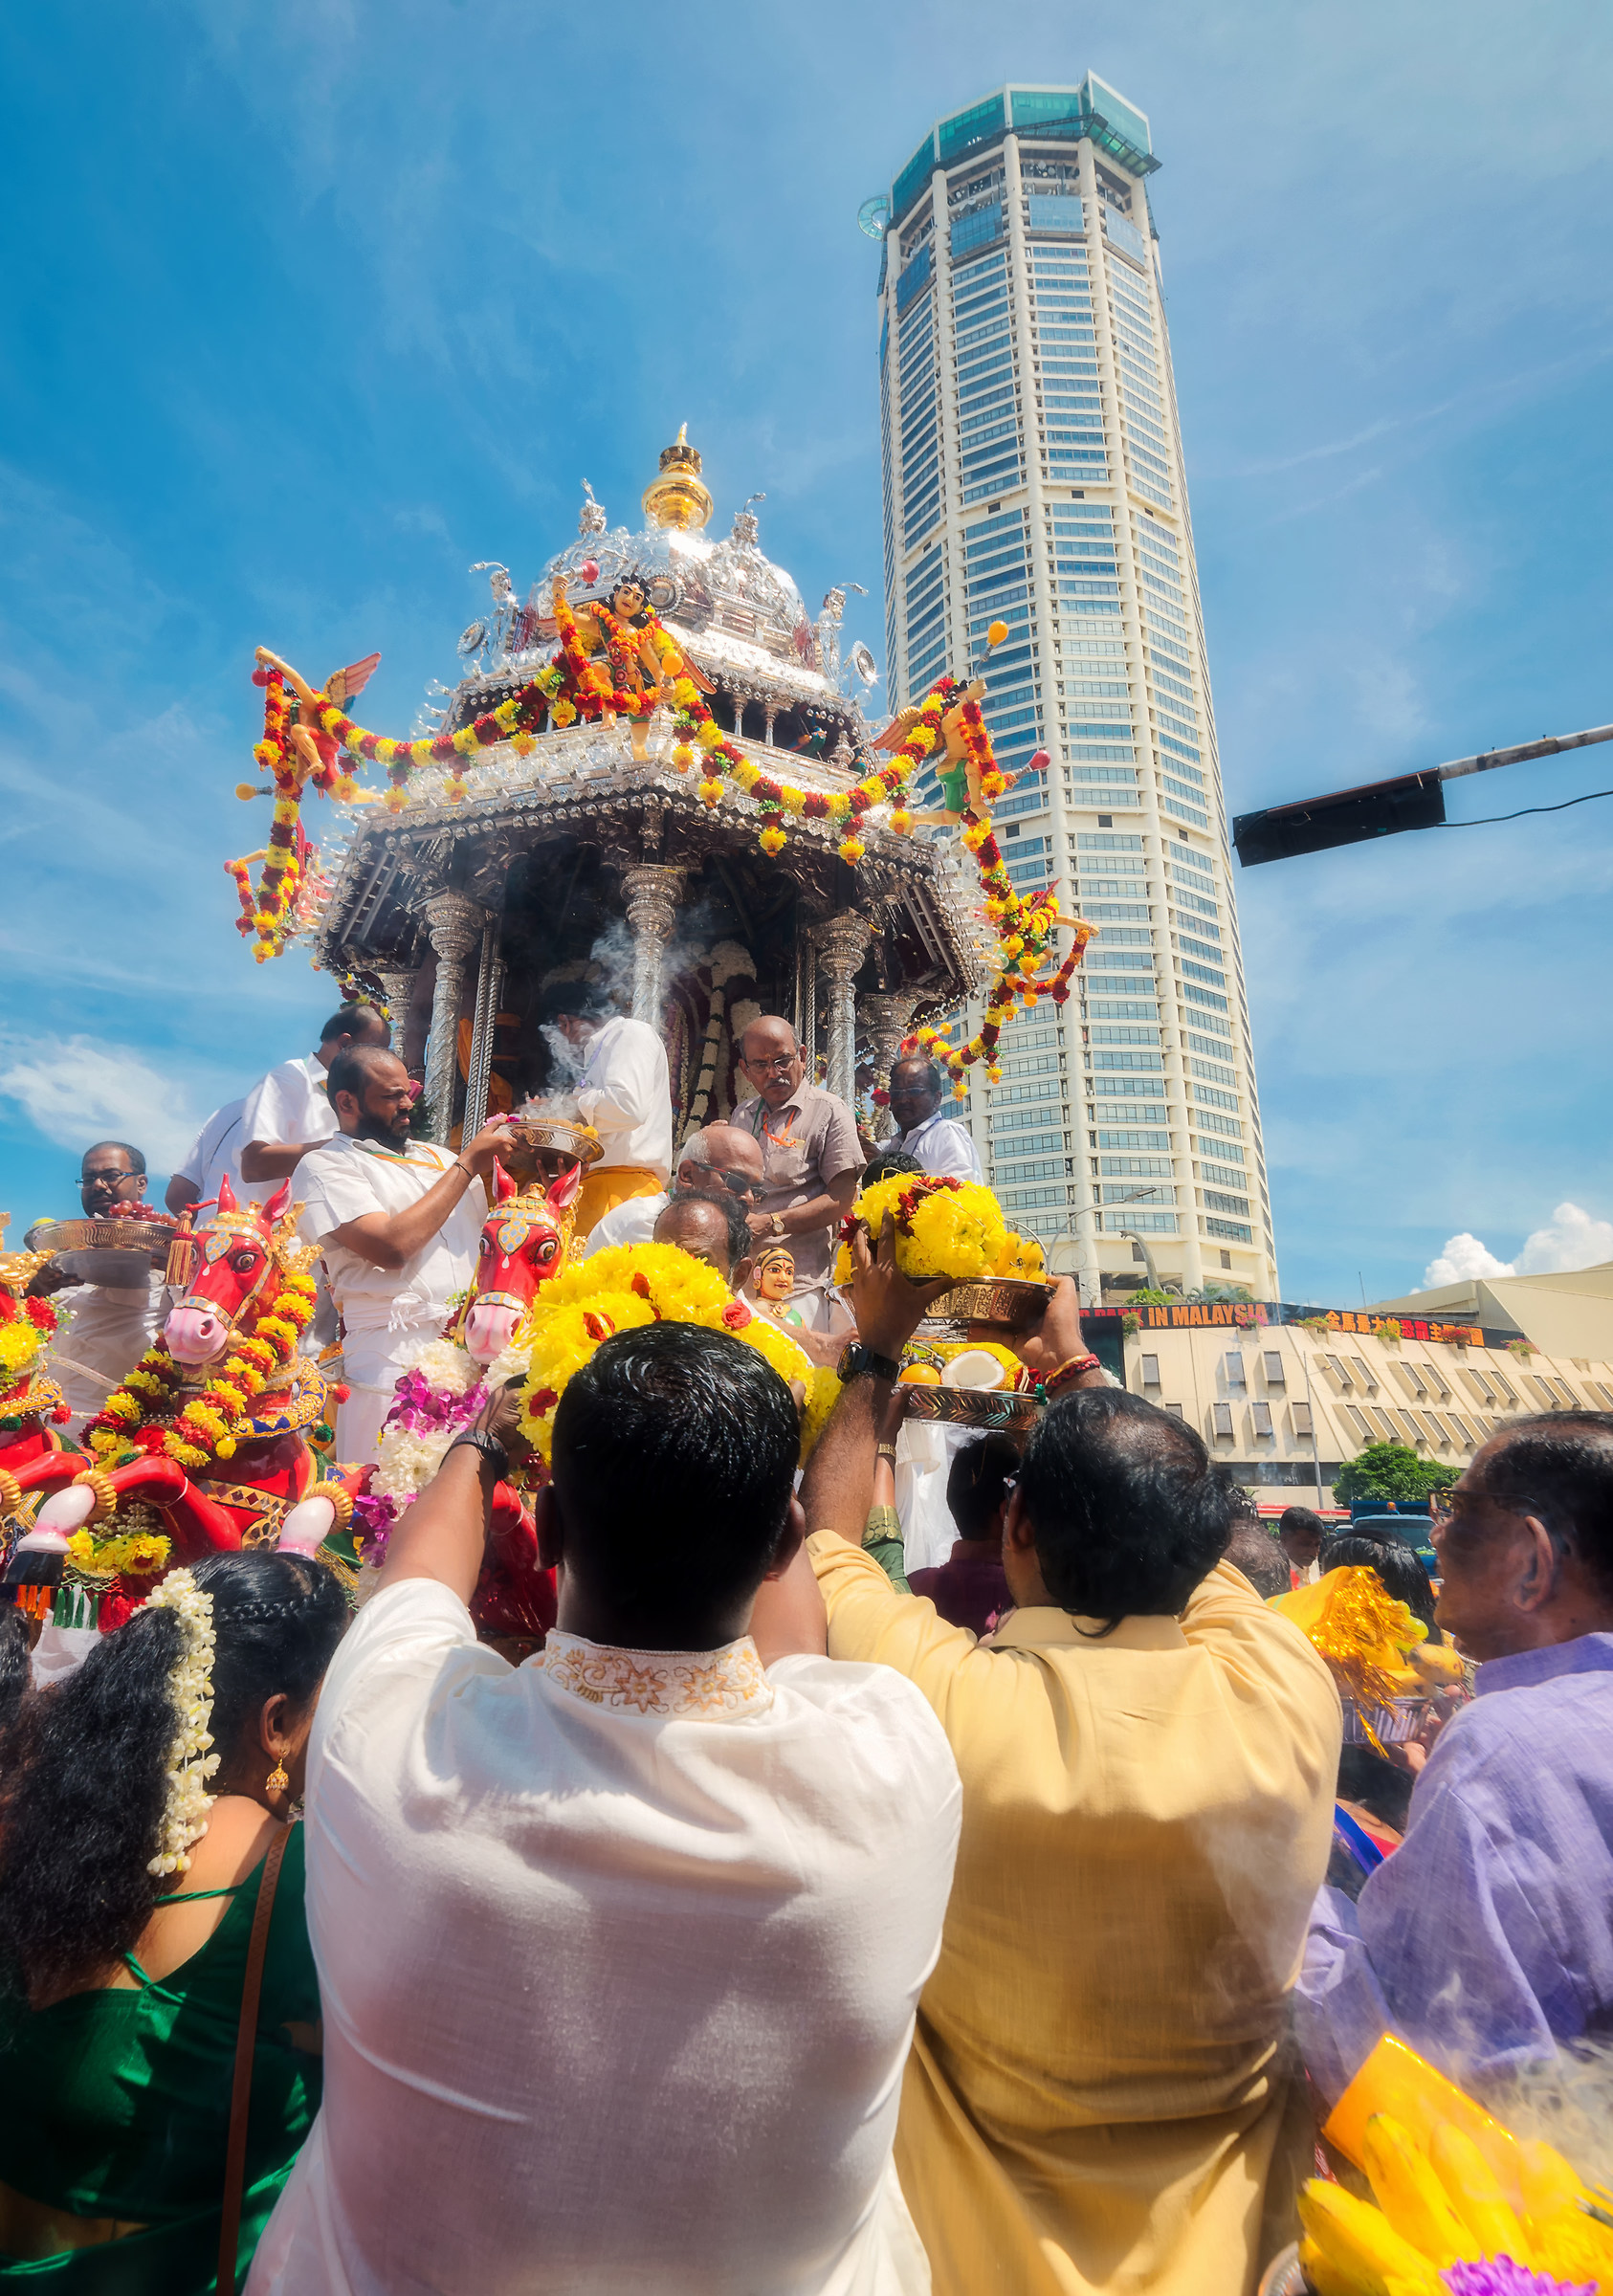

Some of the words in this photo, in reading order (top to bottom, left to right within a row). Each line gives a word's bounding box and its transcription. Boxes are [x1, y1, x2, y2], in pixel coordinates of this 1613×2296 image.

[1148, 1307, 1169, 1327] IN
[1172, 1304, 1269, 1327] MALAYSIA
[1325, 1310, 1485, 1347] 全馬最大的恐龍主園
